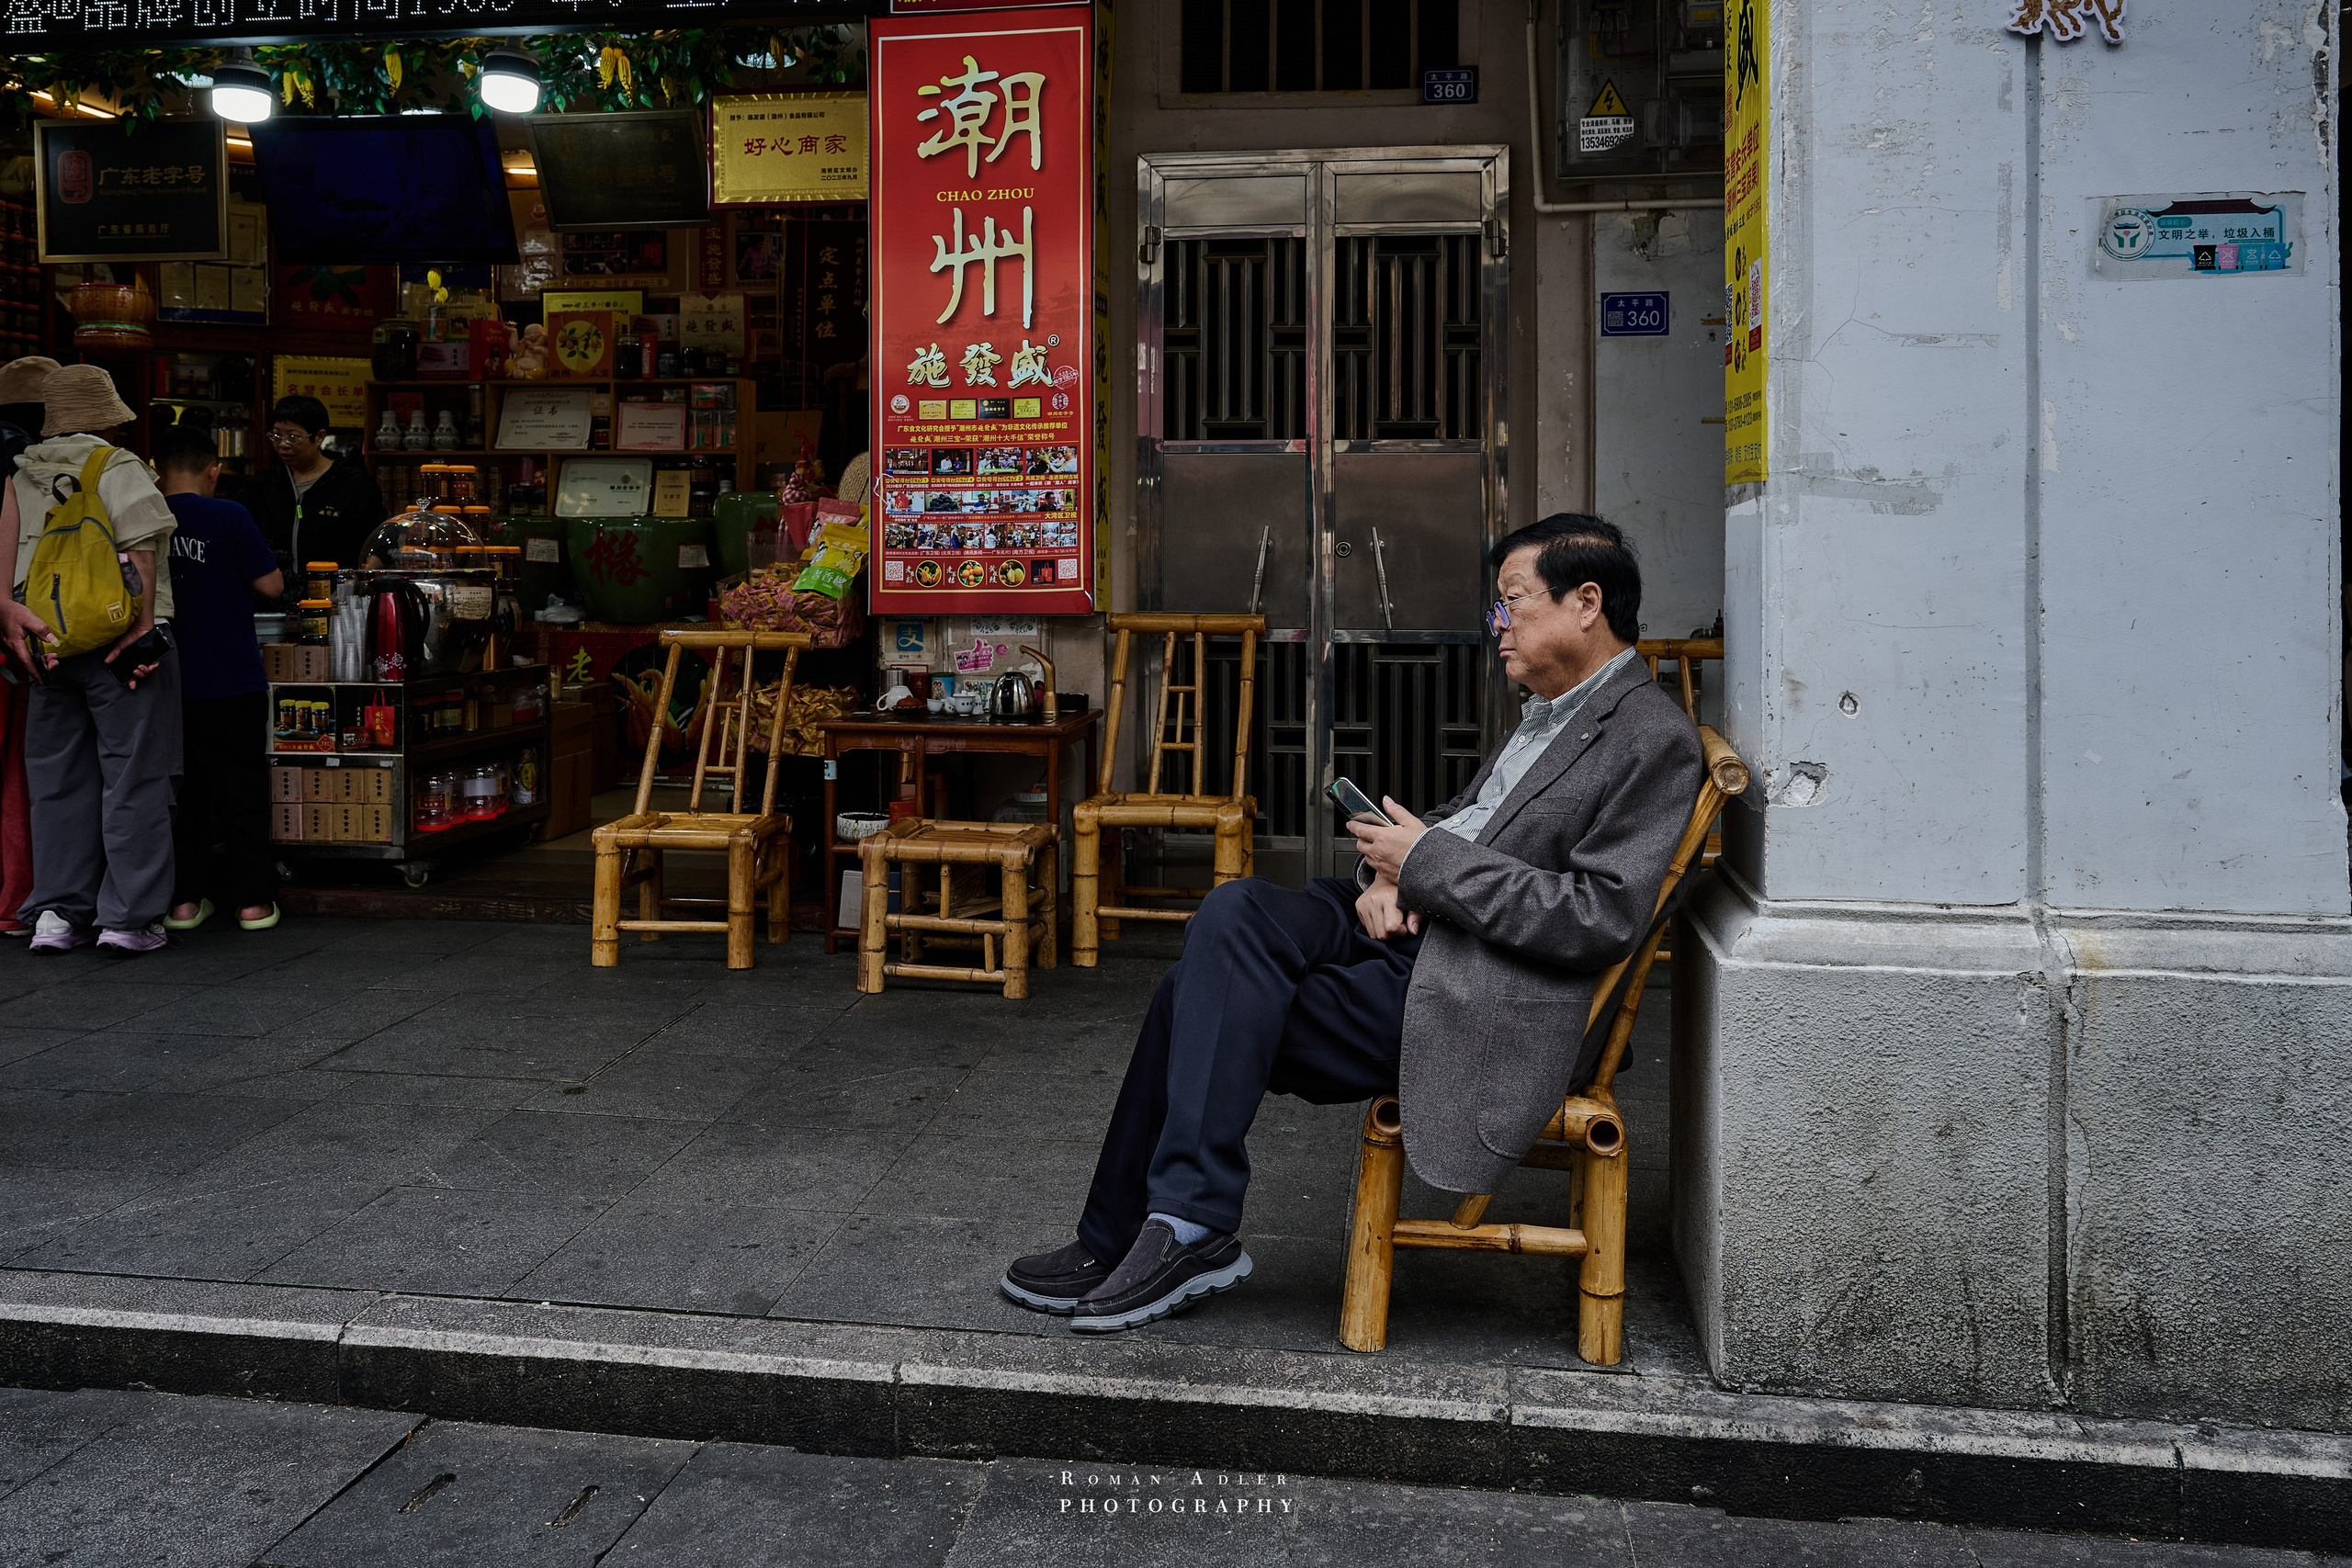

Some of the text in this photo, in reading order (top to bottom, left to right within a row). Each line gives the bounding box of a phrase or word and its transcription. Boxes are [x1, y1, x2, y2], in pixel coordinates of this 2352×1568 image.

[1433, 84, 1465, 98] 360
[917, 55, 1046, 179] 潮
[744, 134, 847, 155] 好心商家
[1580, 134, 1634, 149] 135346926
[98, 165, 206, 186] 广东老字号
[937, 187, 1035, 202] CHAO ZHOU
[930, 206, 1033, 330] 州
[816, 245, 841, 339] 定点单位
[1617, 299, 1655, 308] 太平路
[1627, 310, 1661, 326] 360
[1045, 512, 1078, 520] 大湾区卫视
[566, 646, 595, 682] 老
